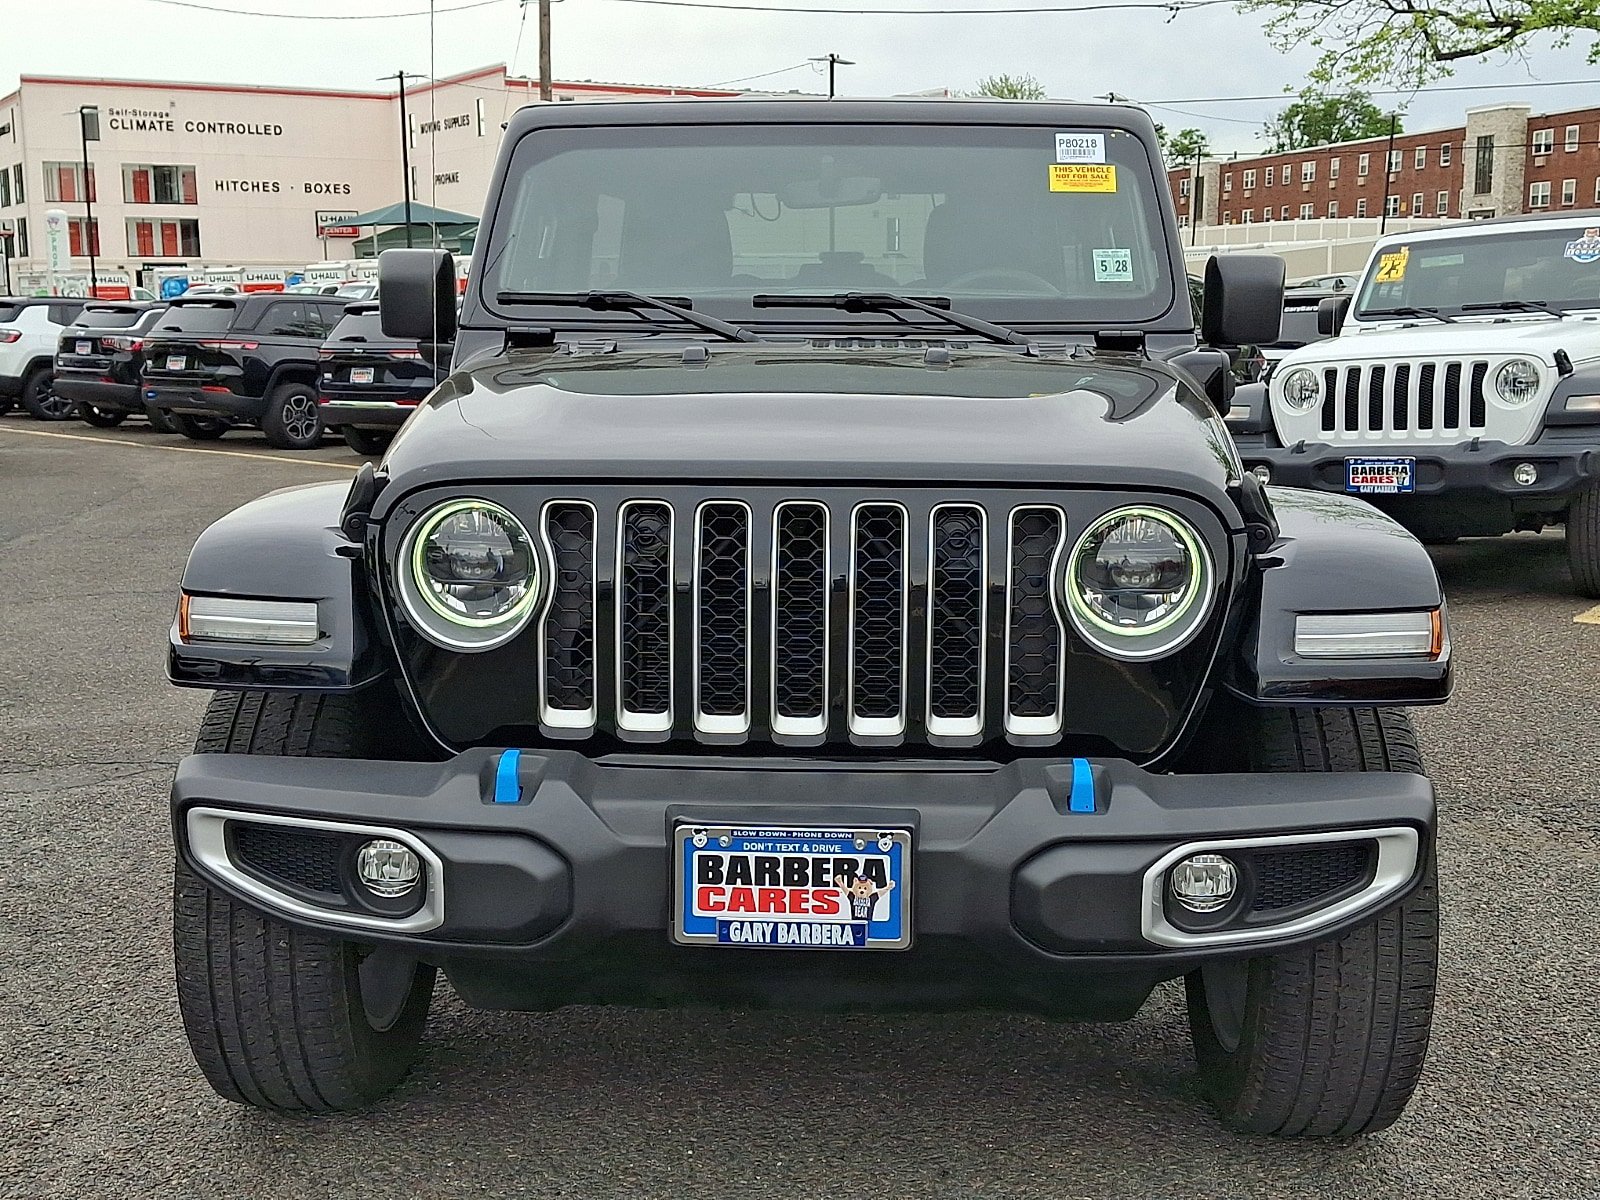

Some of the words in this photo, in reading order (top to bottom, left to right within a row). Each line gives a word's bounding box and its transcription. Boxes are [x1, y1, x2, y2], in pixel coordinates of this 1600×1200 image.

[108, 107, 170, 118] Self-Storage
[109, 118, 175, 132] CLIMATE
[185, 121, 283, 136] CONTROLLED
[444, 114, 470, 130] SUPPLIES
[1058, 138, 1097, 148] P80218
[435, 172, 460, 185] PROPANE
[215, 180, 281, 193] HITCHES
[304, 182, 351, 195] BOXES
[1100, 260, 1108, 272] 5
[1115, 260, 1128, 272] 28
[1376, 259, 1405, 280] 23
[209, 275, 236, 283] U-HAUL
[311, 272, 340, 280] U-HAUL
[1351, 466, 1408, 475] BARBERA
[743, 842, 774, 851] DON'T
[775, 843, 801, 852] TEXT
[802, 844, 810, 852] &
[812, 844, 842, 853] DRIVE
[697, 854, 888, 889] BARBERA
[697, 886, 841, 915] CARES
[729, 921, 774, 943] GARY
[777, 922, 855, 946] BARBERA
